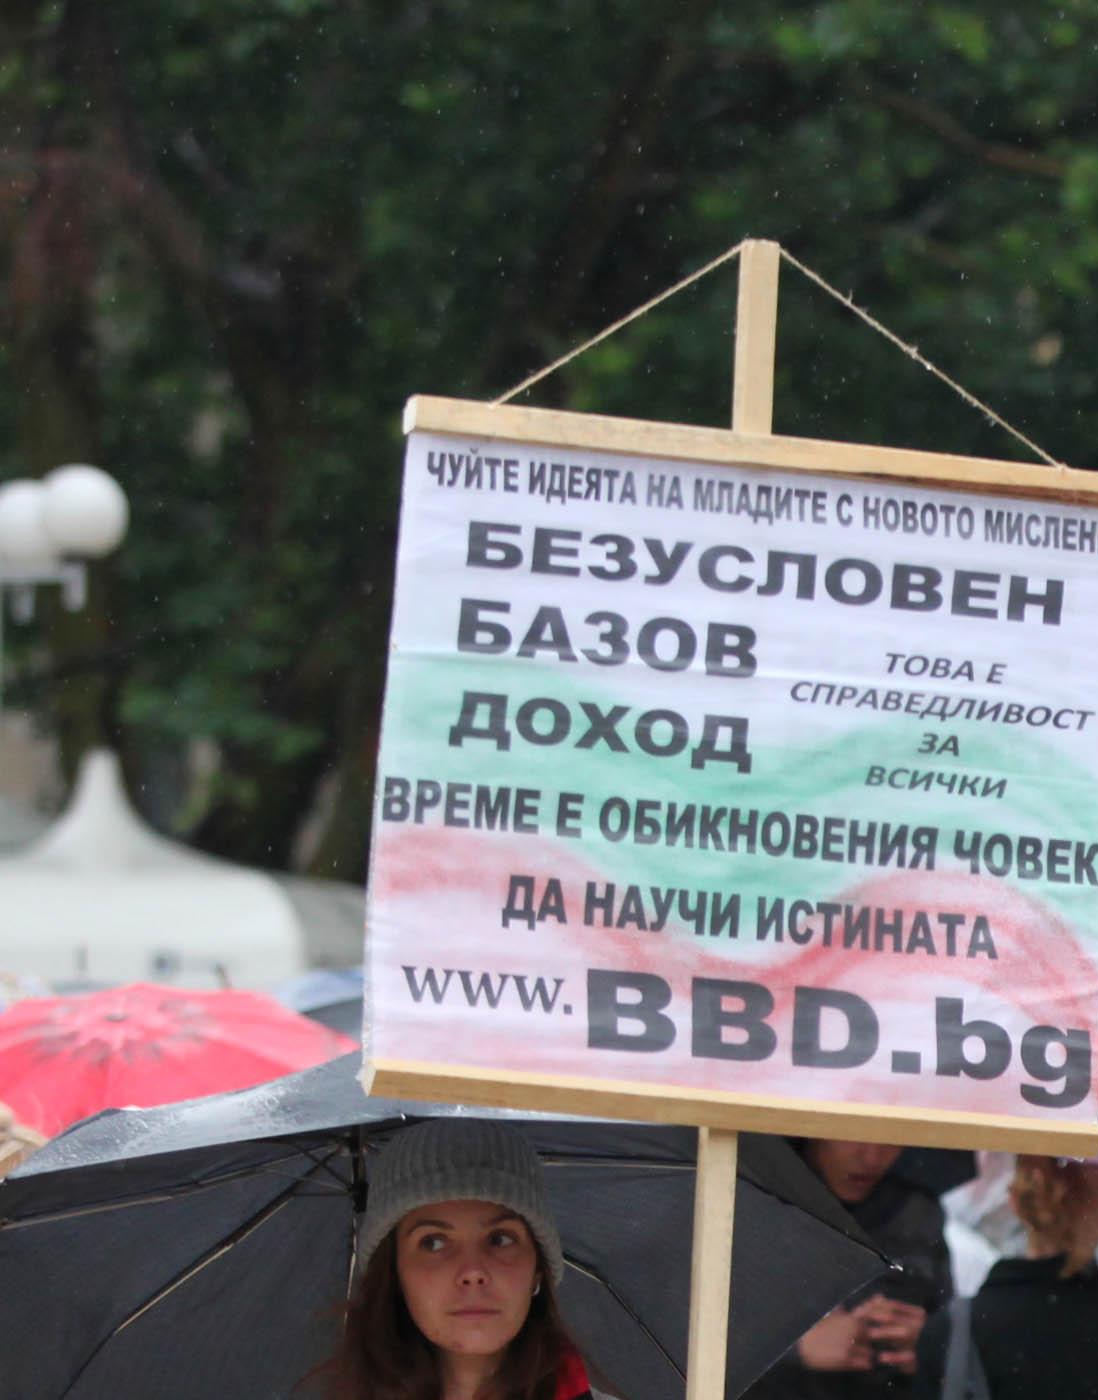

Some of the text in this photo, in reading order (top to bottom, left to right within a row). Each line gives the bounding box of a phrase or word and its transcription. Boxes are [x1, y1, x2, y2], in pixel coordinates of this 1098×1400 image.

[427, 448, 519, 494] ЧУЙТЕ
[528, 457, 637, 507] ИДЕЯТА
[647, 473, 685, 510] НА
[693, 477, 828, 527] МЛАДИТЕ
[836, 493, 854, 527] С
[864, 495, 976, 541] НОВОТО
[465, 520, 1066, 626] БЕЗУСЛОВЕН
[456, 598, 759, 679] БАЗОВ
[885, 652, 1007, 684] ТОВА Е
[449, 691, 752, 774] ДОХОД
[791, 681, 1094, 732] СПРАВЕДЛИВОСТ
[918, 732, 961, 758] ЗА
[382, 776, 541, 833] ВРЕМЕ
[557, 793, 584, 836] Е
[599, 796, 938, 871] ОБИКНОВЕНИЯ
[865, 766, 1007, 799] ВСИЧКИ
[501, 876, 999, 960] ДА НАУЧИ ИСТИНАТА
